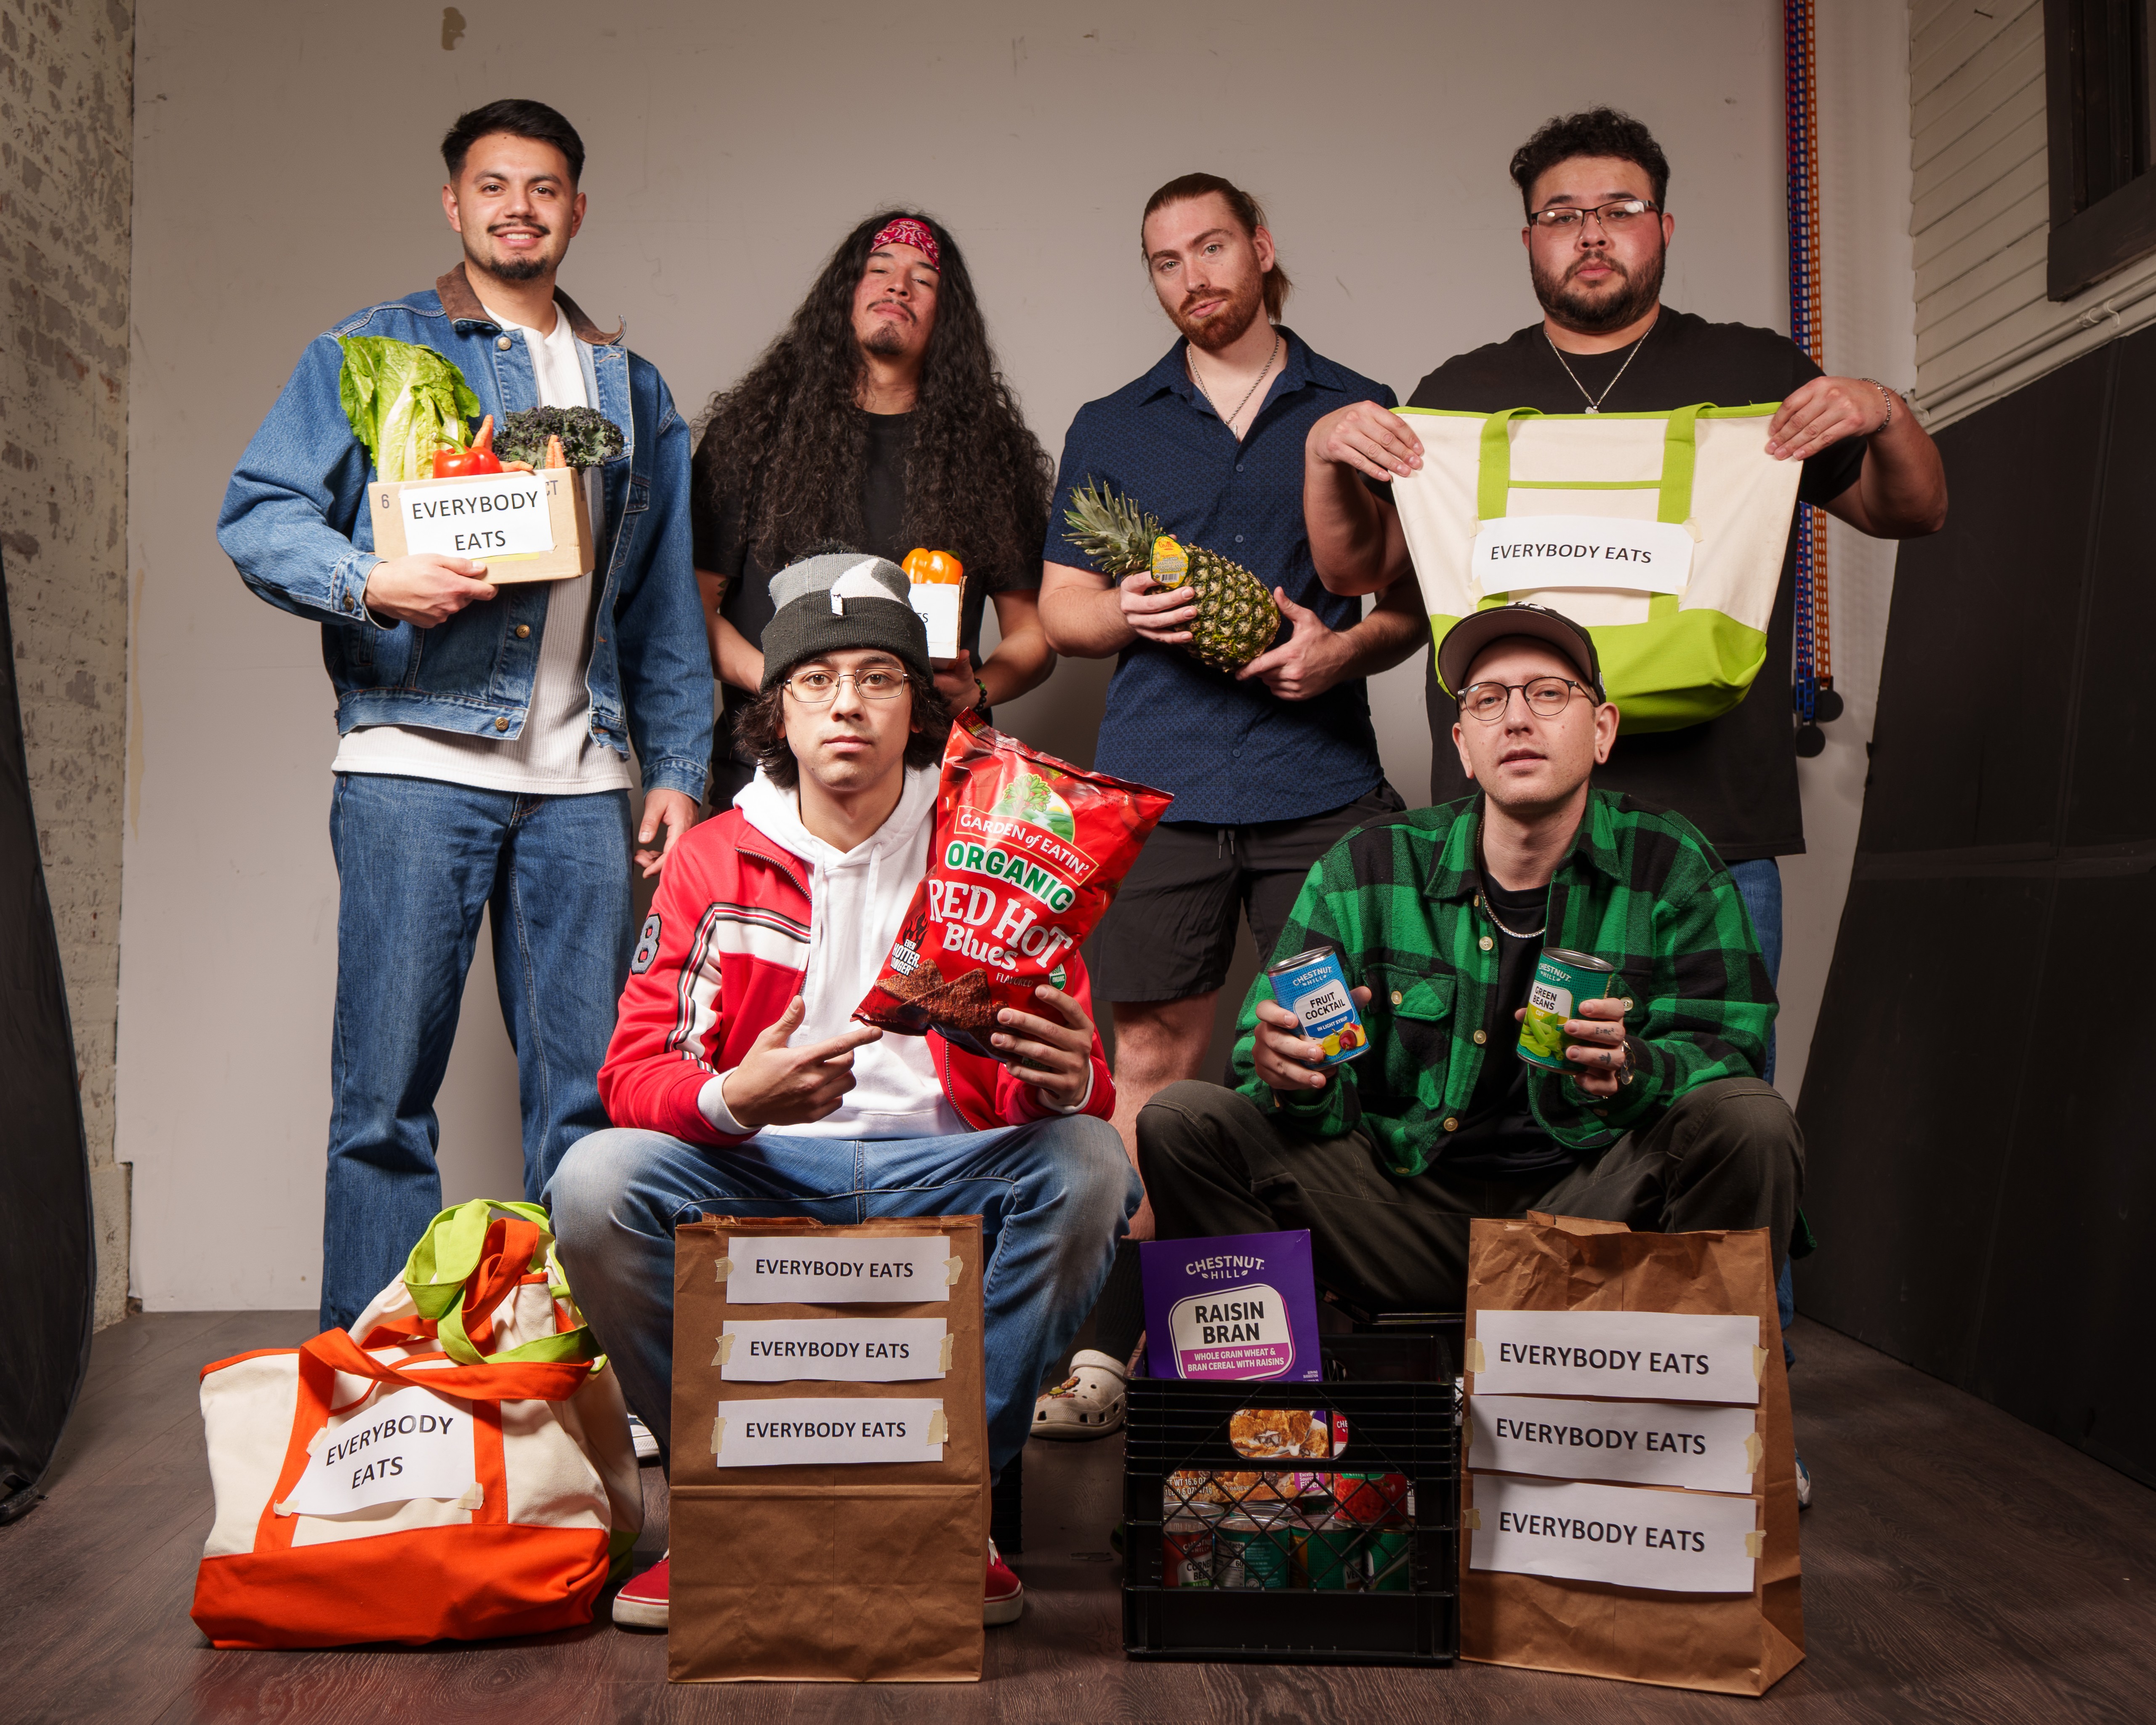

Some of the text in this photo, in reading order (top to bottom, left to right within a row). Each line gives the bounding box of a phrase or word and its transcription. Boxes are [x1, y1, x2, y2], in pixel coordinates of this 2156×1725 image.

[381, 493, 390, 509] 6
[413, 491, 538, 520] EVERYBODY
[455, 530, 506, 551] EATS
[1491, 543, 1652, 563] EVERYBODY EATS
[960, 814, 1026, 841] GARDEN
[1025, 835, 1042, 848] of
[946, 841, 1075, 913] ORGANIC
[928, 879, 1073, 968] RED HOT
[631, 913, 662, 975] 8
[904, 939, 916, 950] EVEN
[942, 922, 1019, 970] Blues
[892, 942, 921, 968] HOTTER,
[996, 972, 1033, 987] FLAVORED
[1293, 966, 1332, 986] CHESTNUT
[1539, 963, 1572, 982] CHESTNUT
[1543, 972, 1556, 981] HILL
[1310, 992, 1335, 1008] FRUIT
[1533, 995, 1555, 1010] BEANS
[1535, 986, 1557, 1001] GREEN
[1305, 999, 1345, 1020] COCKTAIL
[1323, 1022, 1336, 1030] LIGHT
[1336, 1016, 1348, 1025] SYRUP
[756, 1259, 913, 1278] EVERYBODY EATS
[1186, 1256, 1264, 1275] CHESTNUT
[1211, 1270, 1240, 1279] HILL
[1195, 1301, 1264, 1324] RAISIN
[1203, 1323, 1260, 1344] BRAN
[750, 1341, 909, 1359] EVERYBODY EATS
[1194, 1351, 1219, 1361] WHOLE
[1221, 1350, 1243, 1359] GRAIN
[1244, 1348, 1269, 1357] WHEAT
[1500, 1342, 1709, 1375] EVERYBODY EATS
[1187, 1357, 1284, 1372] BRAN CEREAL WITH RAISINS
[745, 1422, 906, 1438] EVERYBODY EATS
[1496, 1418, 1706, 1456] EVERYBODY EATS
[326, 1415, 454, 1466] EVERYBODY
[351, 1456, 403, 1490] EATS
[1499, 1512, 1705, 1552] EVERYBODY EATS
